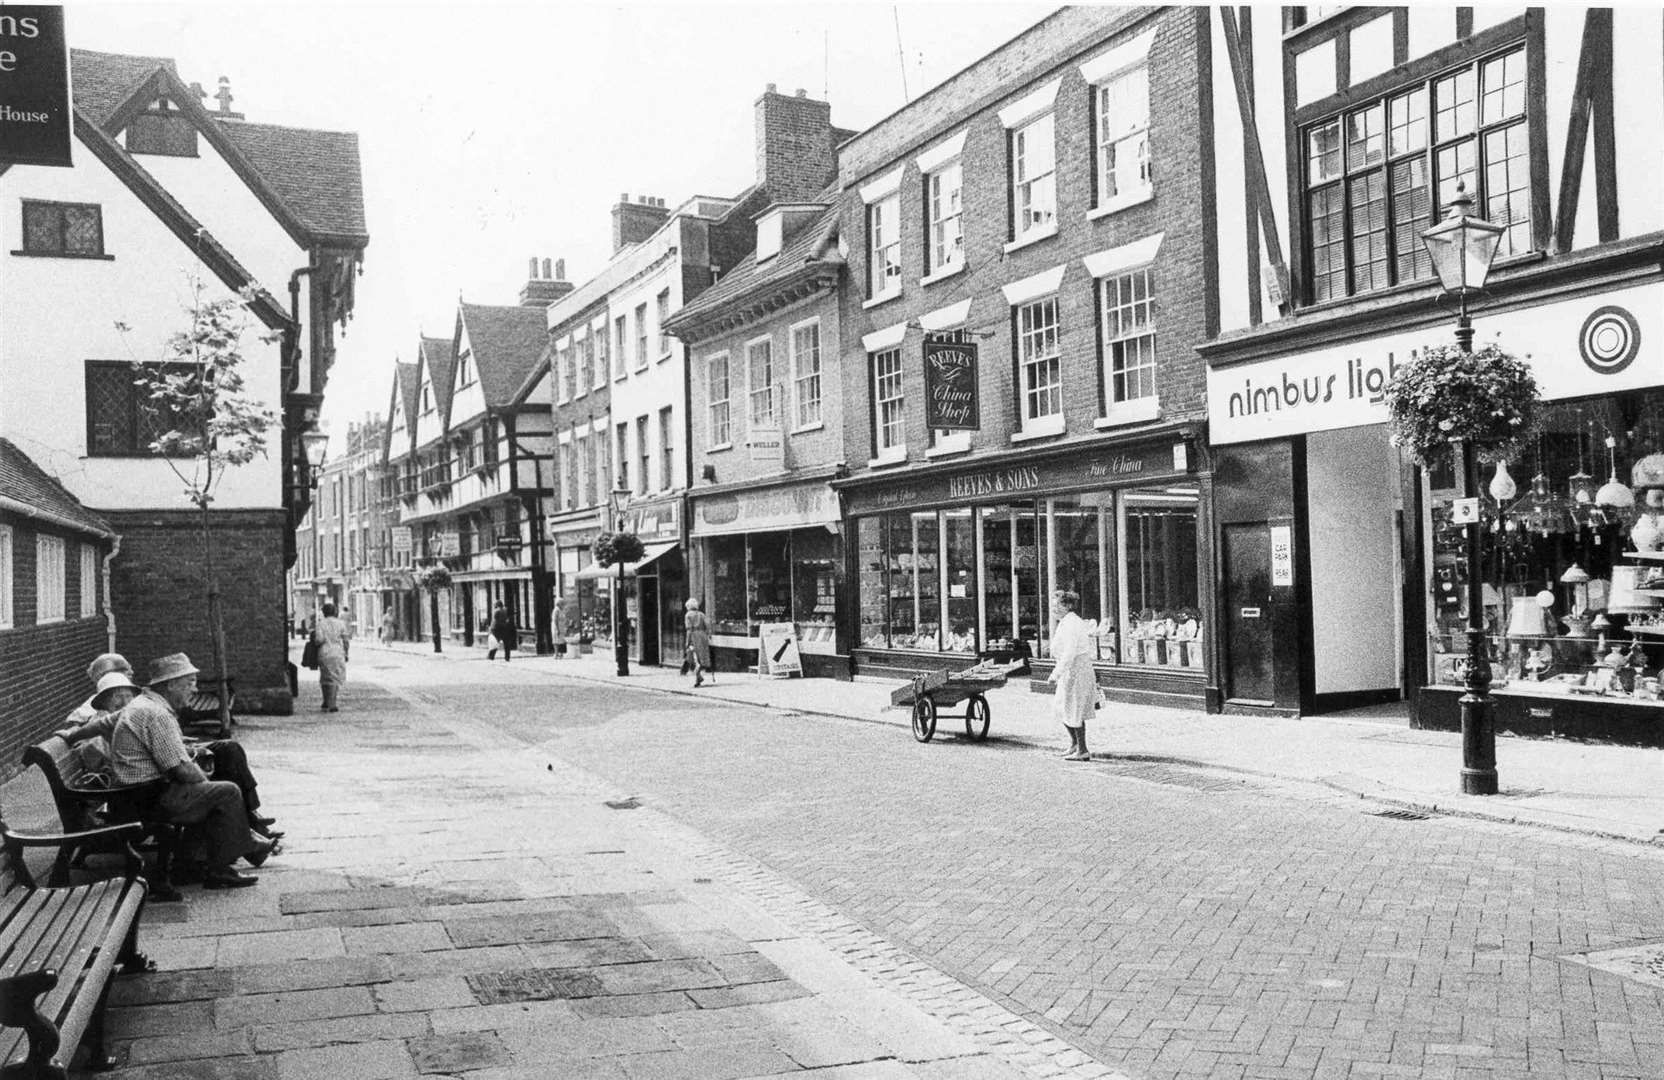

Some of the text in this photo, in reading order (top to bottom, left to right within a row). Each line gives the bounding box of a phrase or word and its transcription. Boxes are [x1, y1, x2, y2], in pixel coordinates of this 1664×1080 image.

[928, 350, 973, 370] REEVES
[932, 384, 972, 401] China
[1229, 372, 1336, 418] nimbus
[935, 401, 970, 424] Shop
[950, 473, 992, 498] REEVES
[995, 471, 1004, 492] &
[1007, 466, 1039, 491] SONS
[1112, 455, 1143, 474] China
